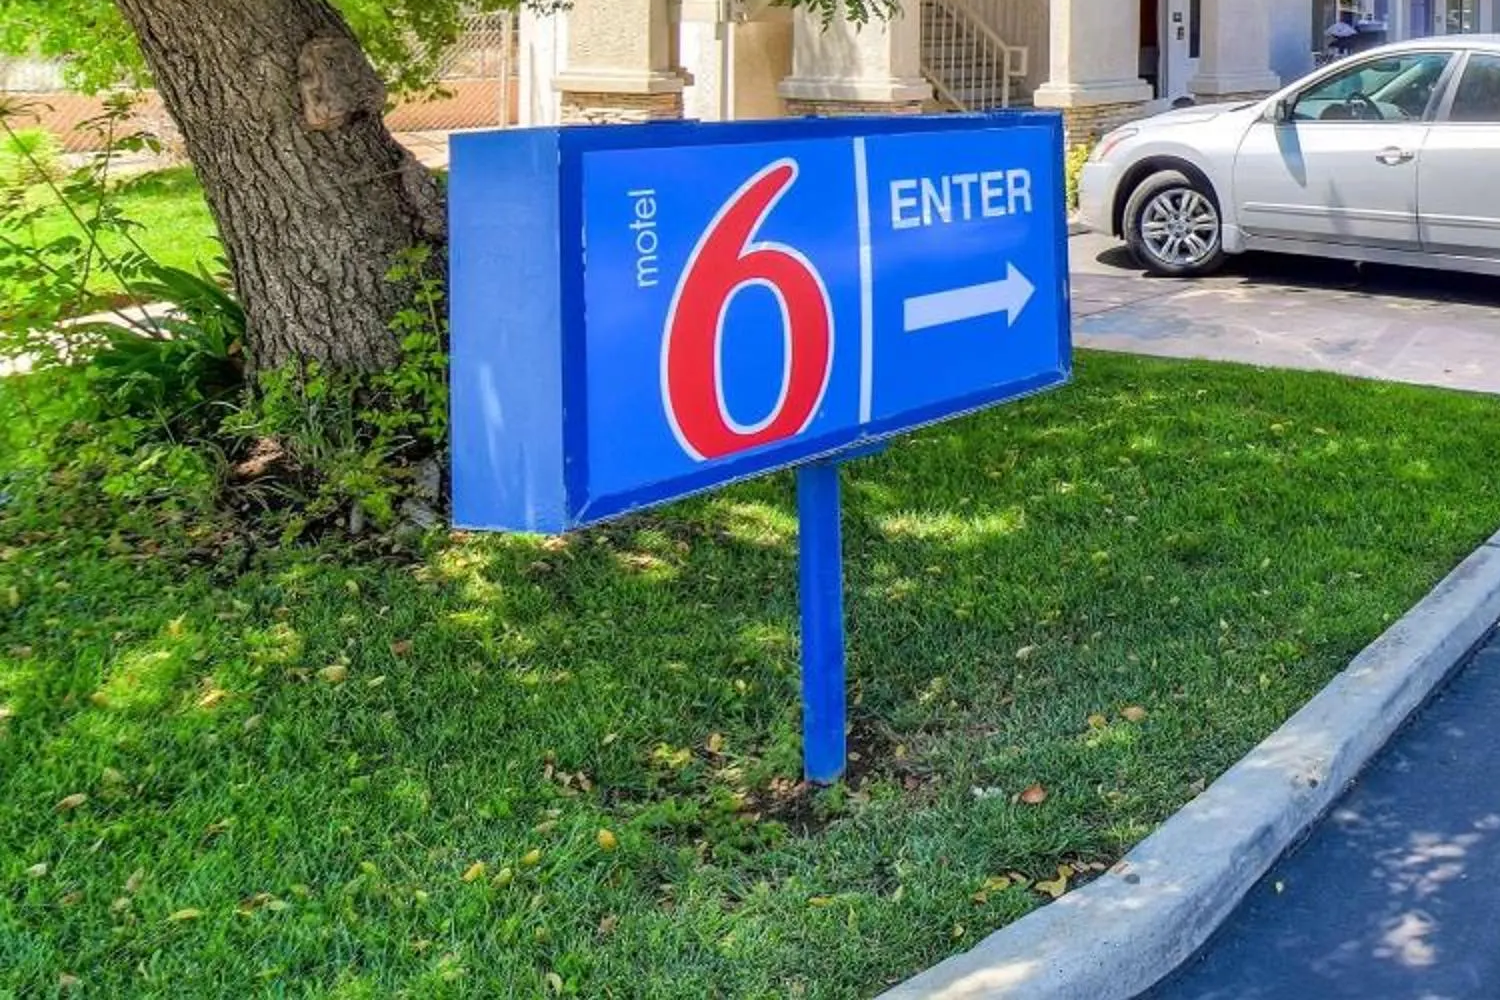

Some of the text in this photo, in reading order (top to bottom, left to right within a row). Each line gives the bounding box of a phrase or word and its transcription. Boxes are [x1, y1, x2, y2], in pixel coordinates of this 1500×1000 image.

[890, 168, 1032, 229] ENTER
[628, 158, 834, 461] motel 6
